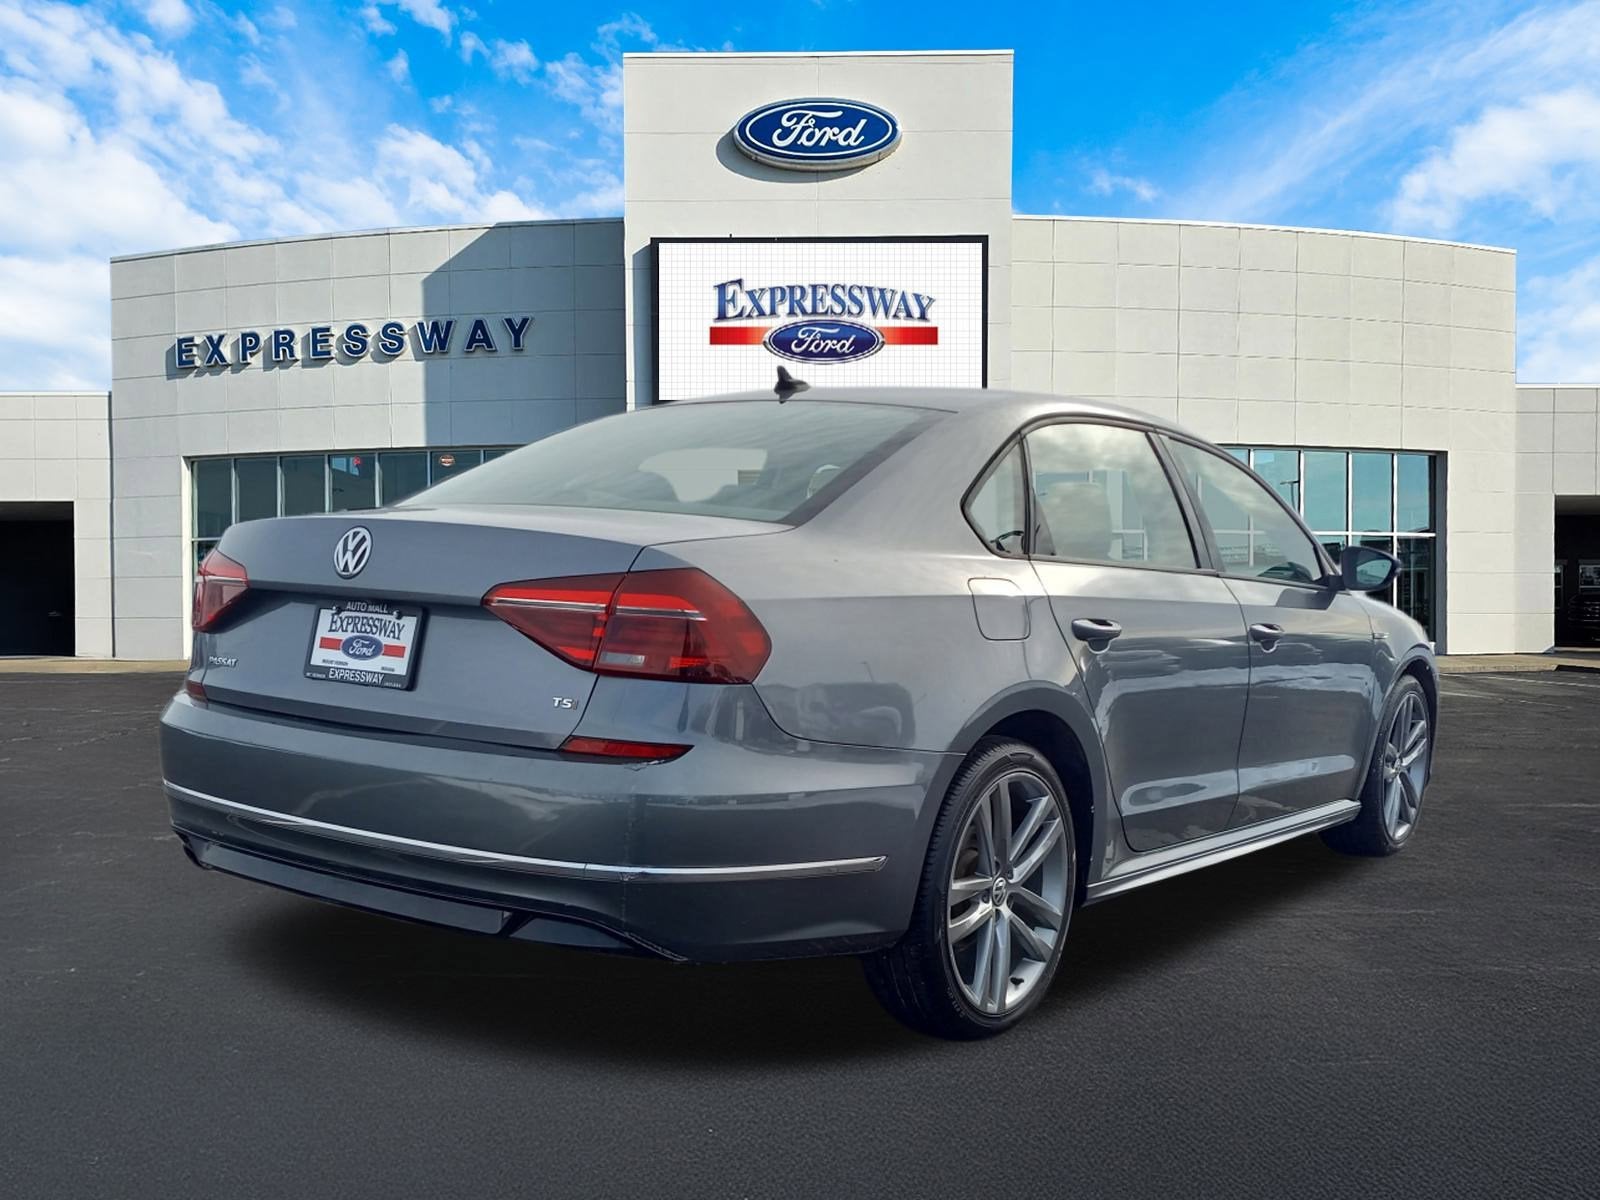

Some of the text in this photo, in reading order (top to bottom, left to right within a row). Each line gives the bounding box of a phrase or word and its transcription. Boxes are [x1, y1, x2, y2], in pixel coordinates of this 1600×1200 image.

[772, 110, 867, 147] Ford
[712, 278, 936, 322] EXPRESSWAY
[175, 315, 534, 369] EXPRESSWAY
[791, 326, 855, 354] Ford
[346, 601, 389, 613] AUTO MALL
[328, 613, 405, 640] EXPRESSWAY
[348, 638, 376, 657] Ford
[328, 668, 384, 685] EXPRESSWAY
